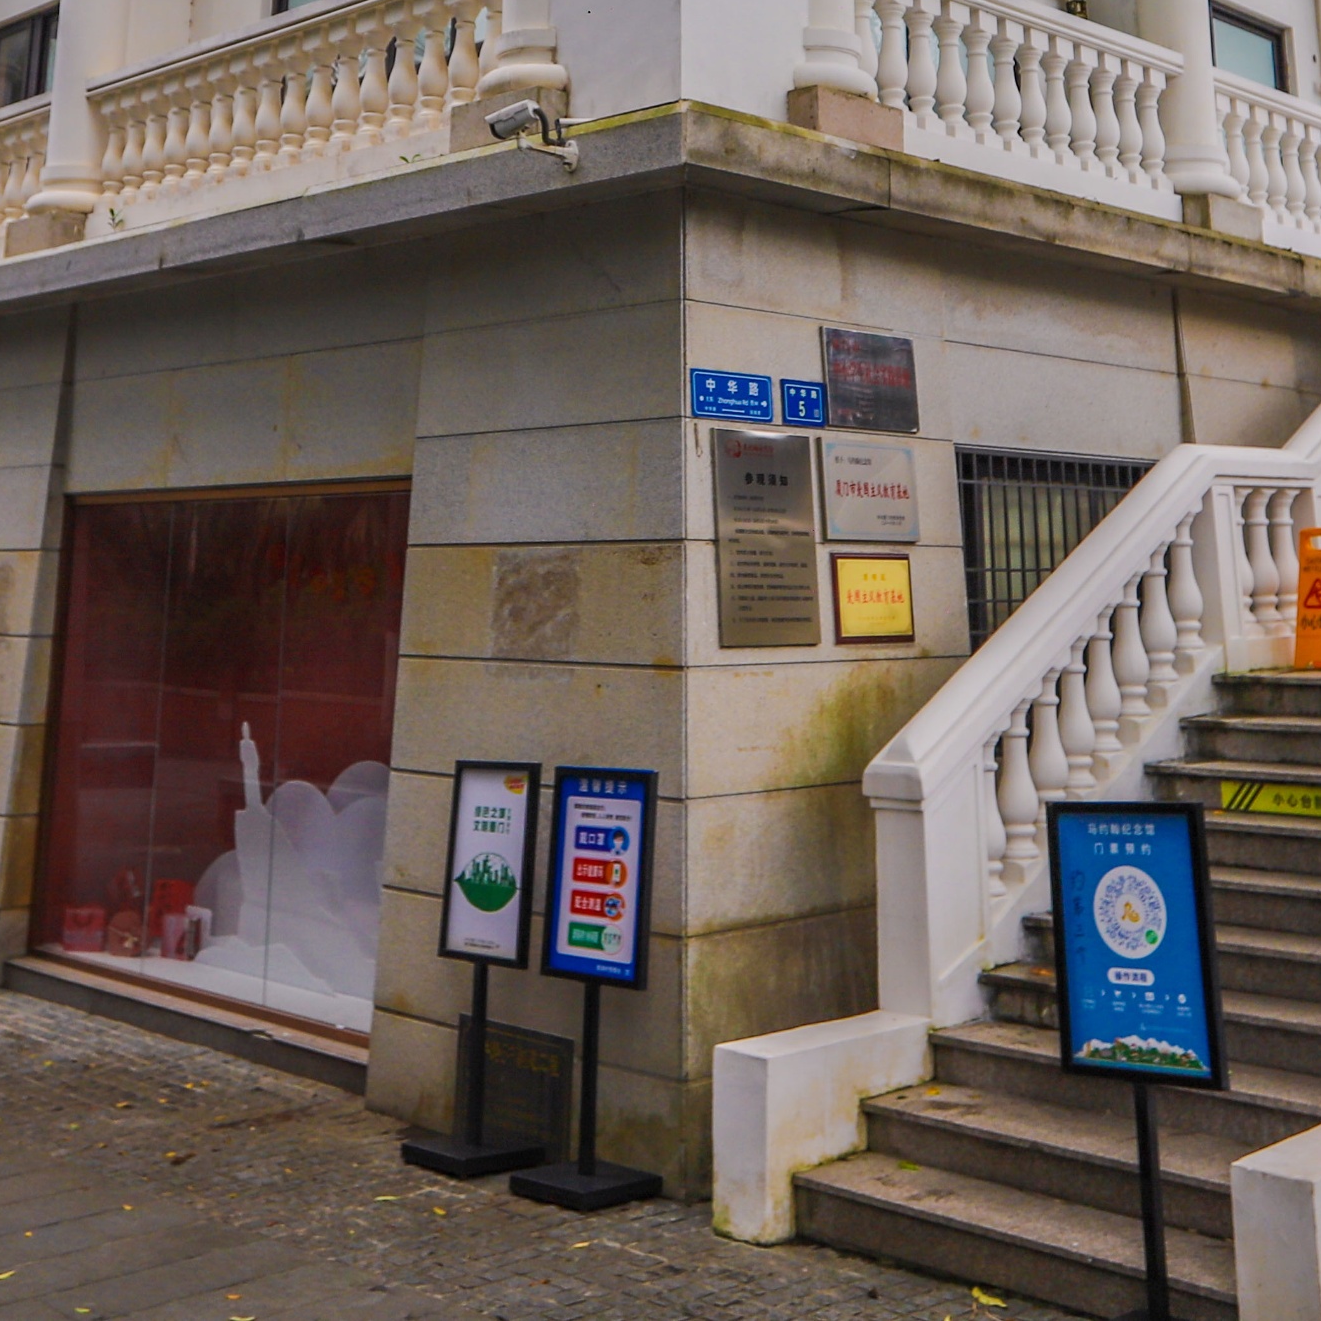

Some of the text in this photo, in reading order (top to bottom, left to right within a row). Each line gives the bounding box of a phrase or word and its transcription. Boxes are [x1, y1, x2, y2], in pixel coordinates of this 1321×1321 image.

[705, 378, 758, 397] 中华路
[798, 401, 806, 417] 5
[745, 472, 789, 486] 参观须知
[836, 479, 910, 500] 厦门市爱国主义教育基地
